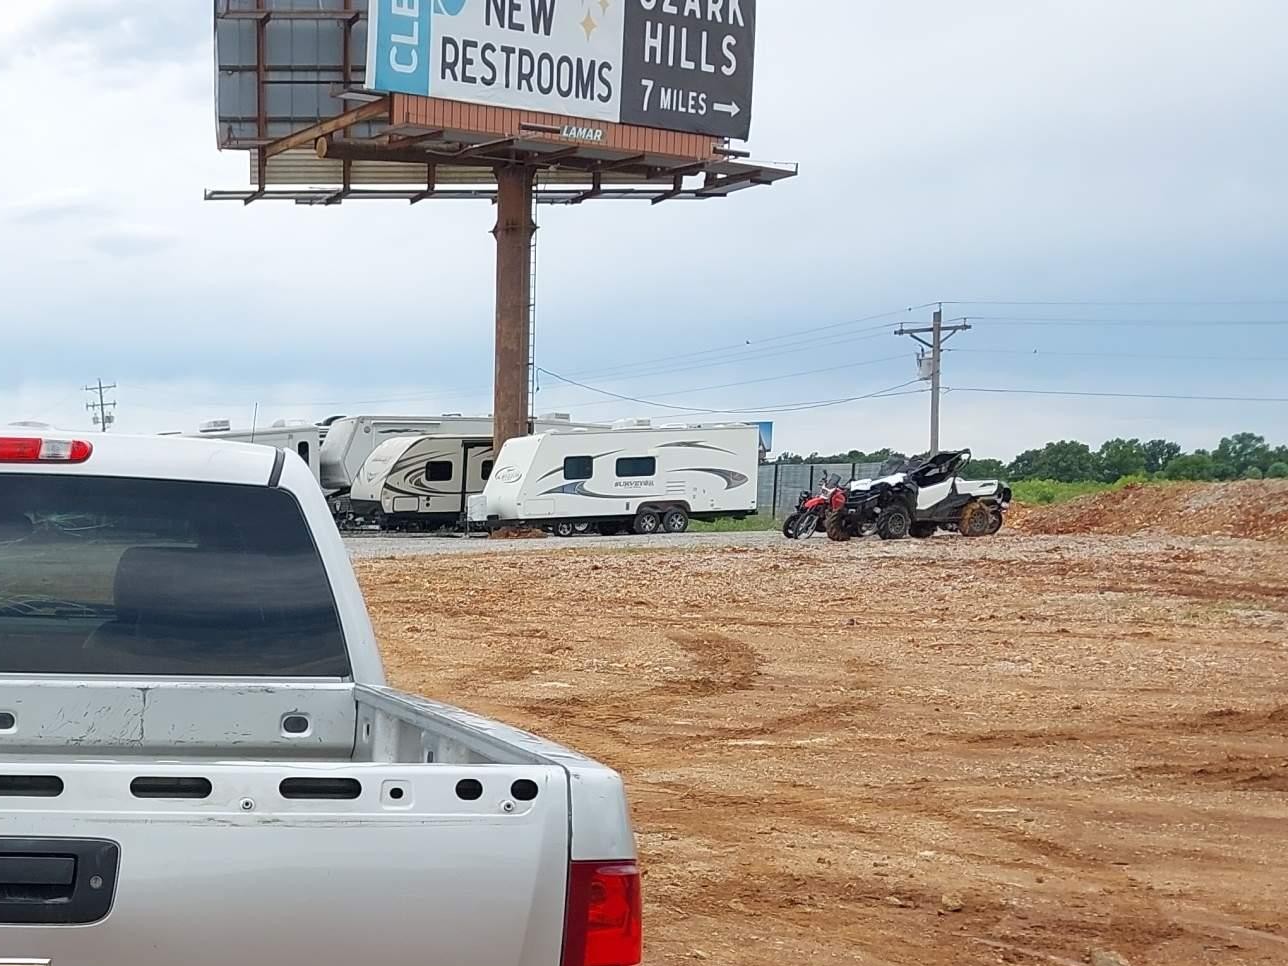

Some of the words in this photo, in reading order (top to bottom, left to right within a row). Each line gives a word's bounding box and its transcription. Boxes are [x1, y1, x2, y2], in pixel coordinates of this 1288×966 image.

[485, 0, 555, 36] NEW
[640, 0, 745, 27] ARK
[644, 20, 737, 76] HILLS
[441, 36, 613, 103] RESTROOMS
[641, 78, 654, 111] 7
[660, 87, 707, 115] MILES
[562, 125, 602, 141] LAMAR
